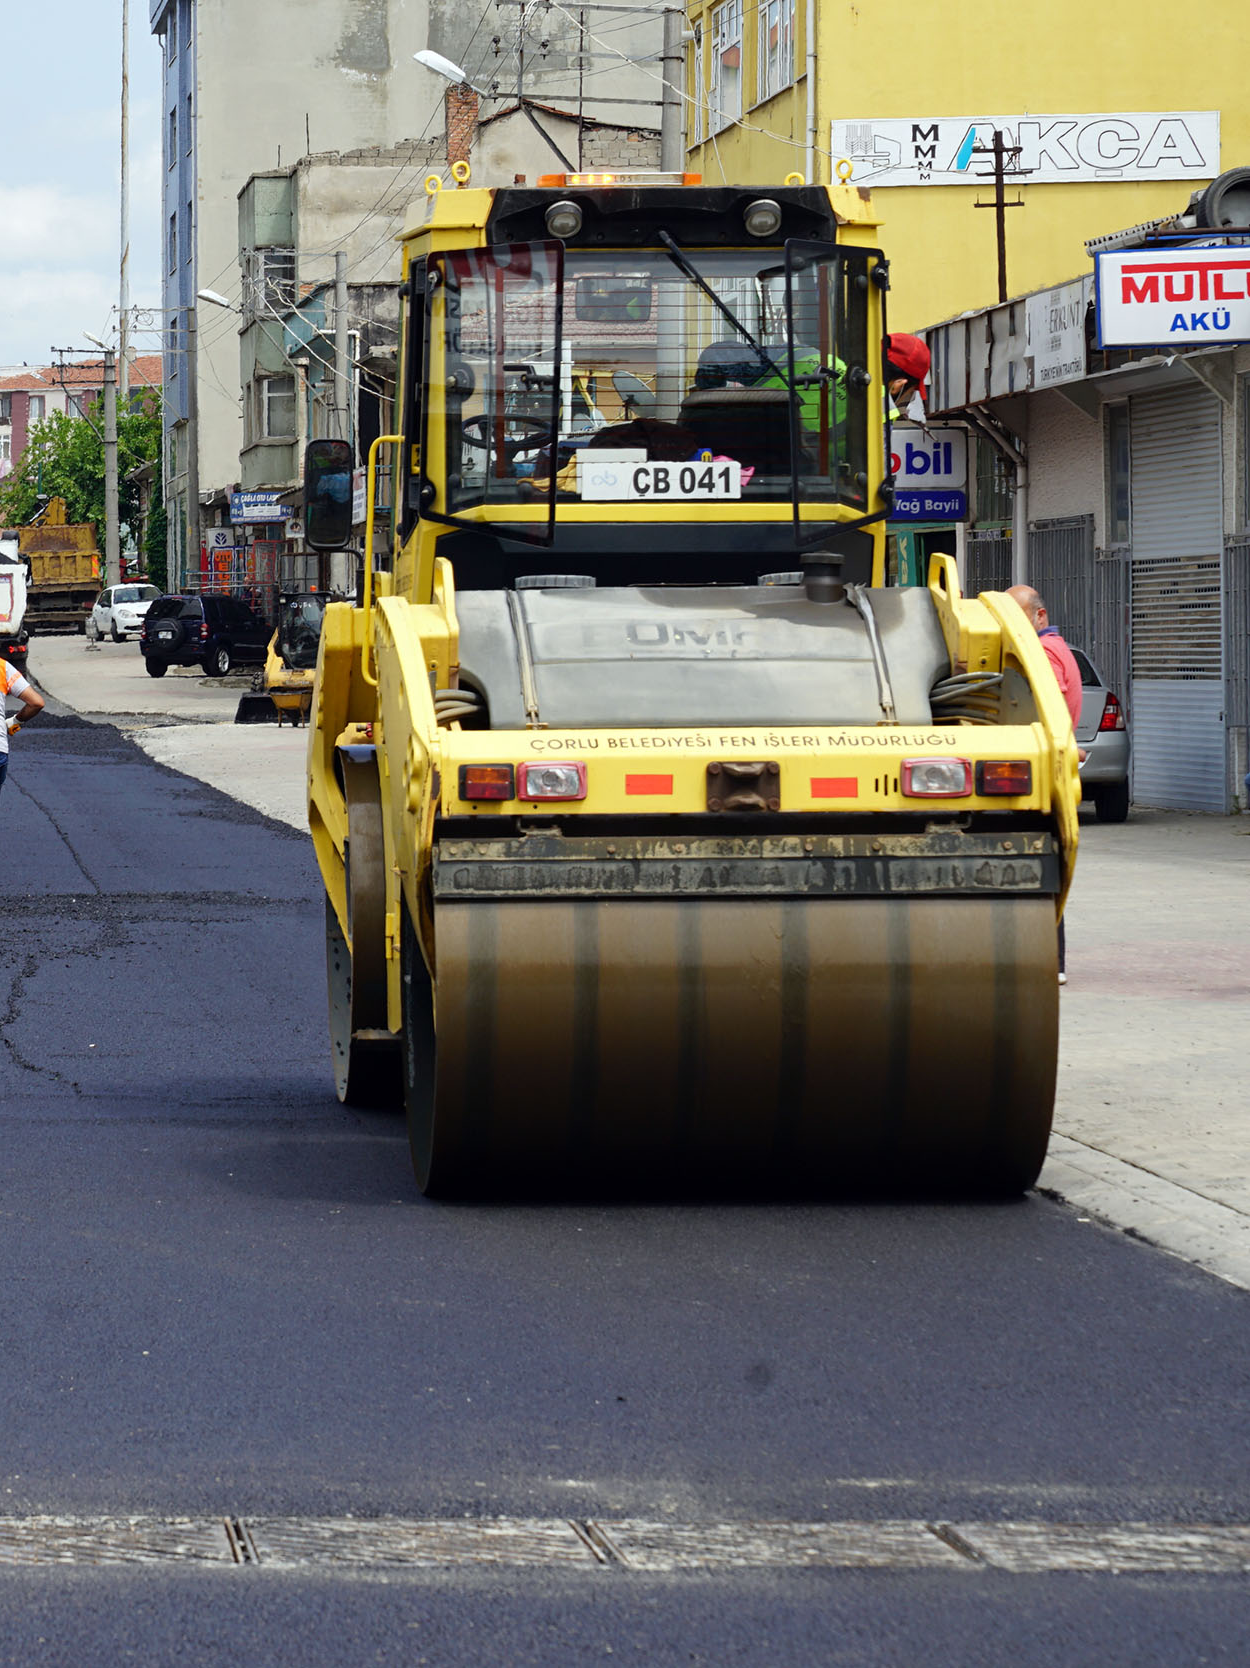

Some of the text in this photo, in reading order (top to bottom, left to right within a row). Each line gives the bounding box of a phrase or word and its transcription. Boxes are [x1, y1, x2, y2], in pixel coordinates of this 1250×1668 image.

[946, 118, 1206, 178] AKÇA
[1121, 260, 1250, 304] MUTL
[1170, 307, 1230, 332] AKÜ
[632, 466, 731, 497] ÇB 041
[925, 498, 960, 514] Bayii
[530, 738, 599, 753] ÇORLU
[719, 736, 756, 747] FEN
